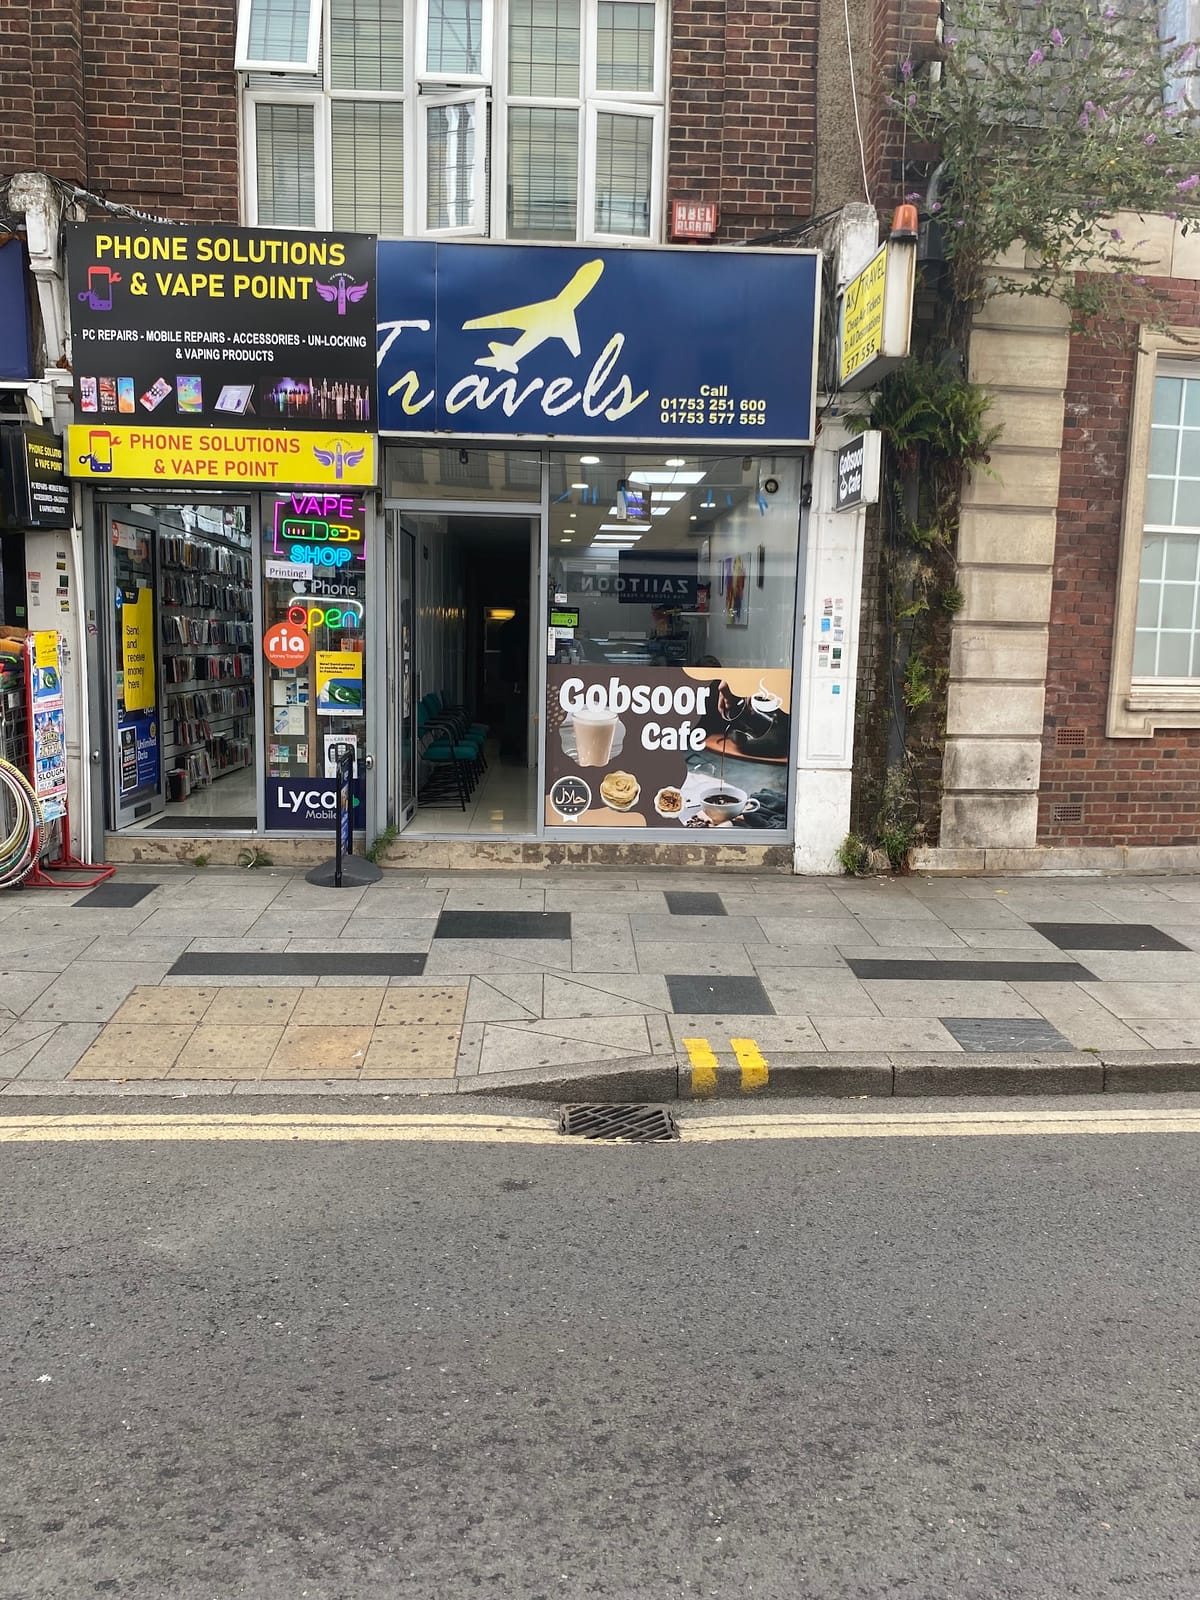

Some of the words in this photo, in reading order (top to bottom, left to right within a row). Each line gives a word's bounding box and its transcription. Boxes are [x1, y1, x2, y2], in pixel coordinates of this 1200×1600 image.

[678, 206, 712, 221] ABEL
[677, 220, 712, 232] ALARM
[96, 235, 188, 260] PHONE
[196, 238, 345, 266] SOLUTIONS
[130, 272, 148, 296] &
[155, 272, 225, 298] VAPE
[233, 274, 314, 300] POINT
[861, 258, 885, 296] TRAVEL
[866, 294, 882, 315] Tickets
[82, 329, 95, 340] PC
[97, 329, 139, 341] REPAIRS
[146, 330, 182, 342] MOBILE
[184, 331, 225, 343] REPAIRS
[233, 333, 300, 345] ACCESSORIES
[308, 335, 367, 347] UN-LOCKING
[856, 312, 881, 343] Destinations
[175, 348, 183, 359] &
[184, 348, 220, 361] VAPING
[222, 349, 274, 361] PRODUCTS
[846, 352, 860, 375] 577
[861, 338, 876, 362] 555
[700, 385, 728, 396] Call
[660, 398, 705, 410] 01753
[709, 399, 734, 410] 251
[740, 400, 766, 411] 600
[660, 412, 704, 424] 01753
[709, 413, 735, 425] 577
[739, 413, 766, 425] 555
[130, 433, 193, 450] PHONE
[199, 436, 300, 454] SOLUTIONS
[154, 458, 166, 474] &
[171, 459, 218, 475] VAPE
[225, 461, 279, 477] POINT
[848, 470, 861, 495] Cafe
[291, 492, 353, 518] VAPE
[290, 544, 352, 567] SHOP
[269, 567, 307, 579] Printing!
[311, 579, 357, 595] iPhone
[126, 625, 139, 636] Send
[269, 628, 305, 652] ria
[126, 639, 138, 649] and
[559, 676, 710, 715] Gobsoor
[641, 720, 707, 751] Cafe
[38, 767, 65, 782] SLOUGH
[278, 786, 337, 813] Lyca
